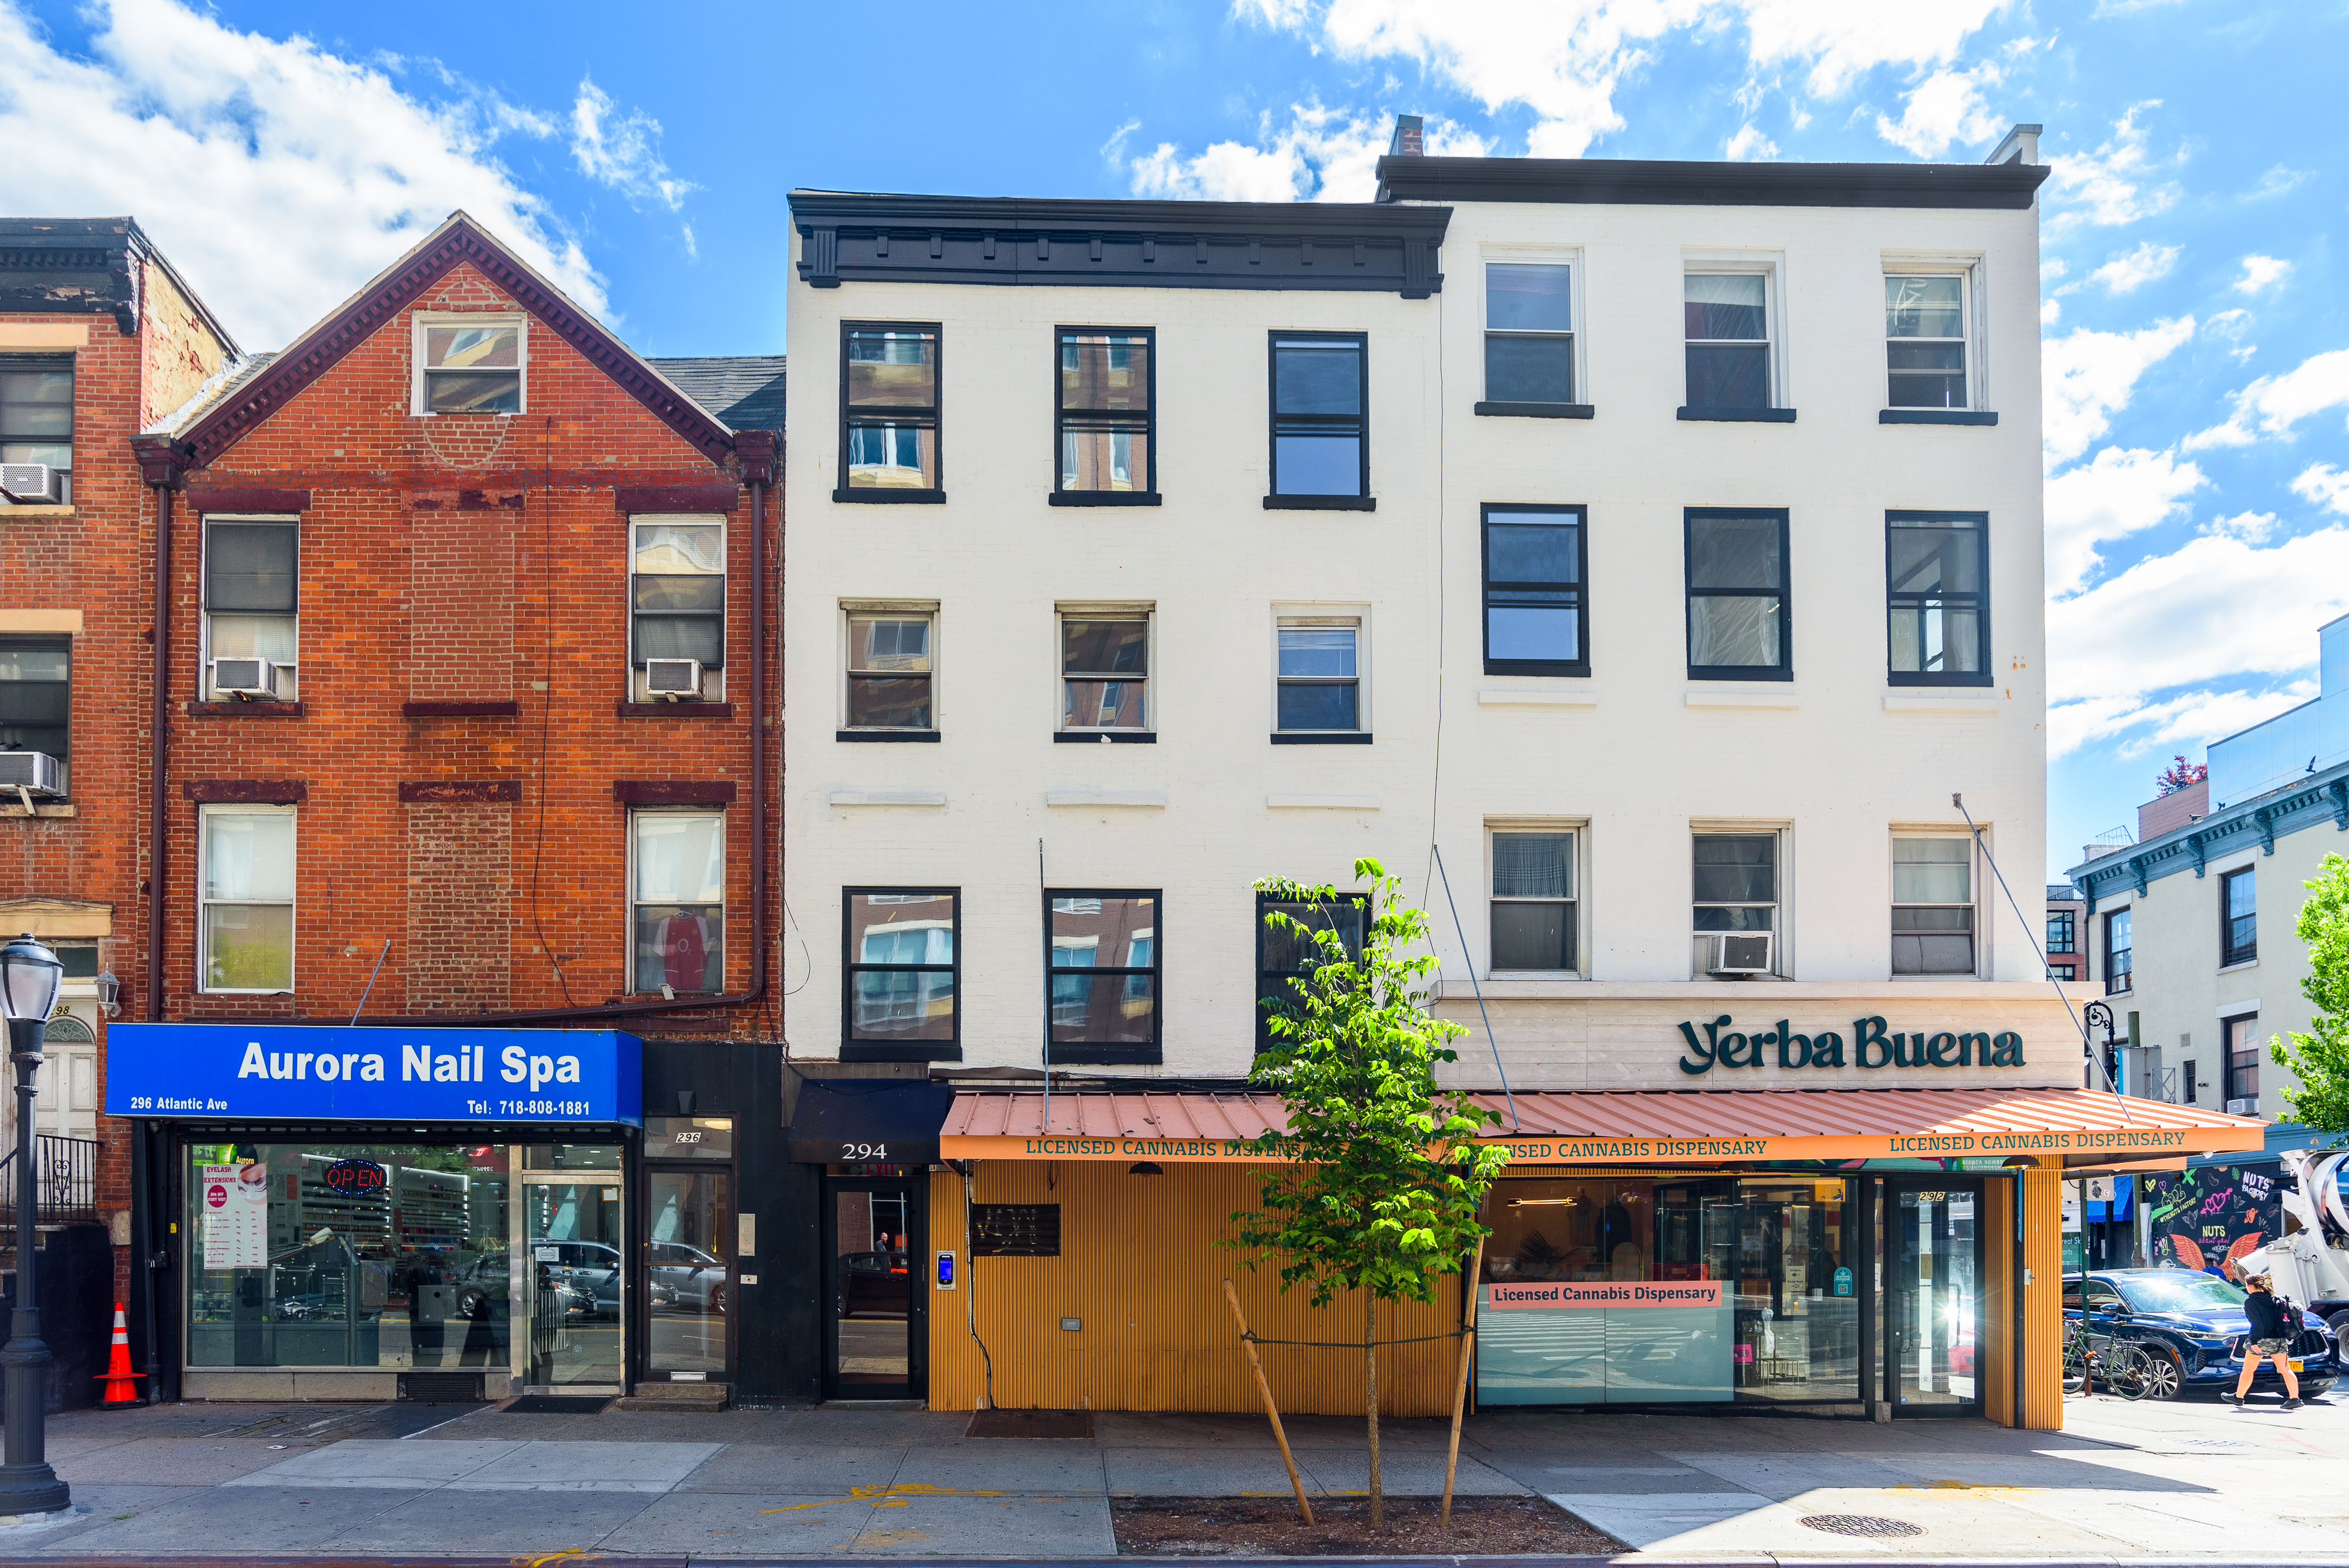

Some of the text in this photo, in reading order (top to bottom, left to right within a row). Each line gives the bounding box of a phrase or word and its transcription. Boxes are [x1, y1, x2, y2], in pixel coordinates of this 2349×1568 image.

[51, 1006, 69, 1015] 98
[1677, 1014, 2027, 1075] Yerba Buena
[237, 1042, 580, 1092] Aurora Nail Spa
[131, 1097, 227, 1110] 296 Atlantic Ave
[467, 1100, 590, 1115] Tel: 718-808-1881
[677, 1133, 699, 1142] 296
[1890, 1132, 2186, 1152] LICENSED CANNABIS DISPENSARY
[842, 1144, 887, 1159] 294
[1027, 1140, 1115, 1154] LICENSED
[1123, 1140, 1216, 1156] CANNABIS
[1559, 1142, 1650, 1158] CANNABIS
[1656, 1140, 1767, 1156] DISPENSARY
[236, 1156, 254, 1164] Aurora
[328, 1169, 382, 1186] OPEN
[2243, 1171, 2269, 1192] NUTS
[1919, 1192, 1944, 1201] 292
[2242, 1185, 2269, 1201] FACTORY
[2202, 1226, 2226, 1237] NUTS
[1495, 1286, 1716, 1303] Licensed Cannabis Dispensary
